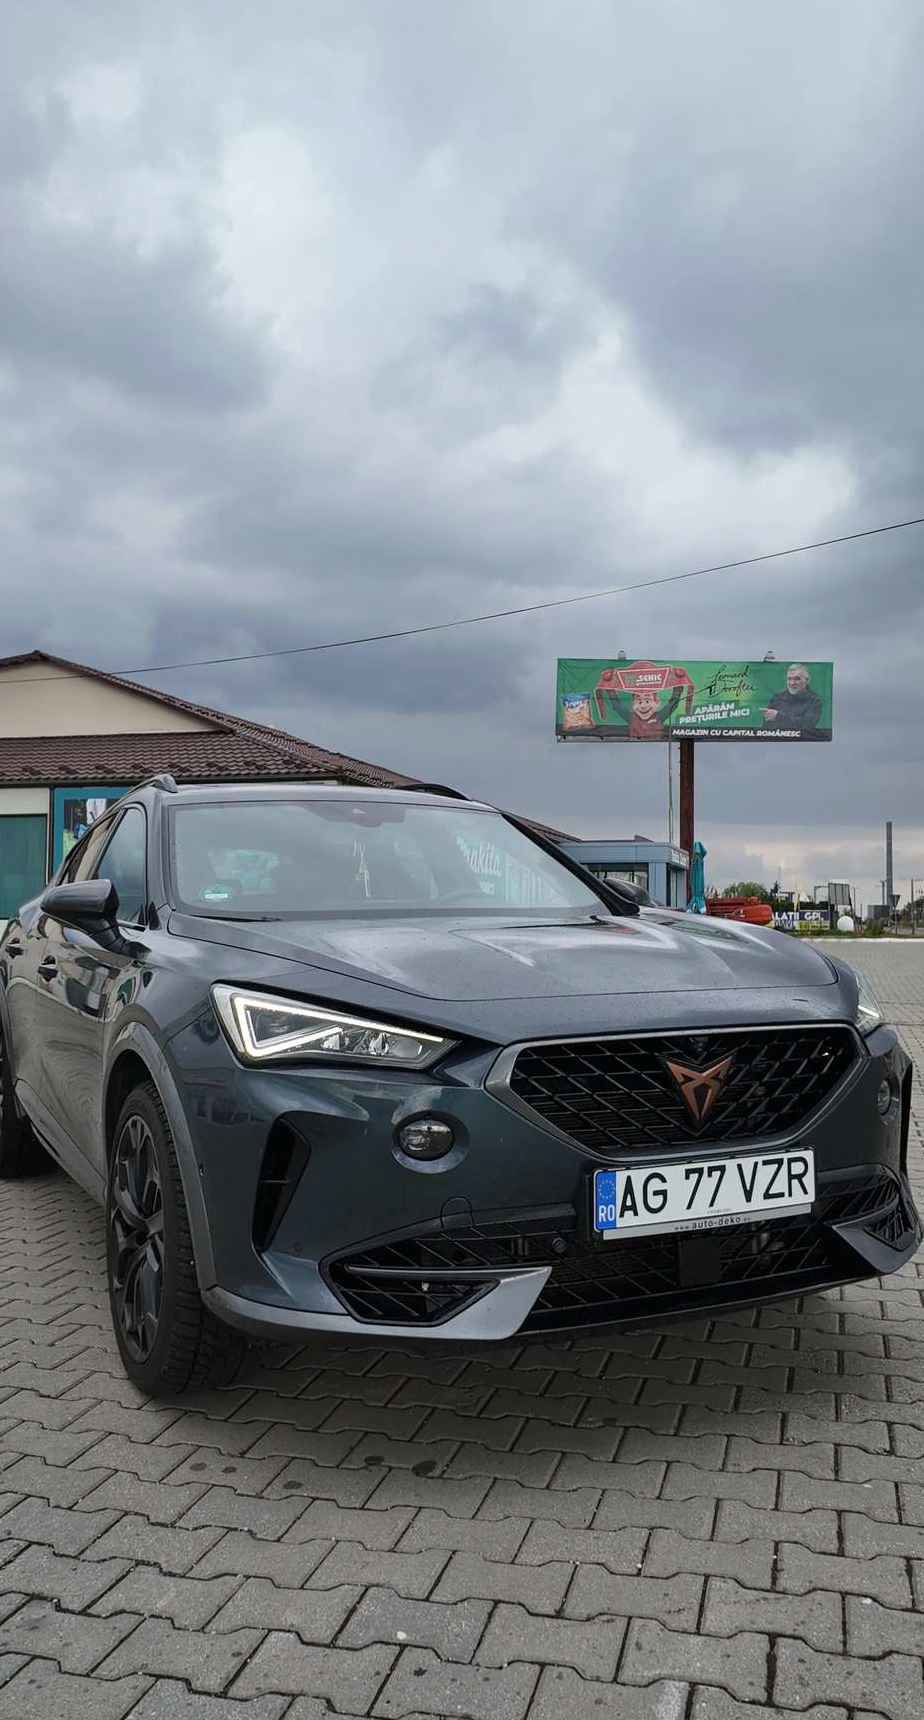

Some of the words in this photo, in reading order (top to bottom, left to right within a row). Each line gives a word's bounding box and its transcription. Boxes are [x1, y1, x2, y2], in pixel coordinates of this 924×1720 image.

[730, 708, 750, 718] MICI
[722, 729, 755, 737] CAPITAL
[618, 1172, 669, 1219] AG
[684, 1164, 727, 1210] 77
[736, 1155, 810, 1204] VZR
[599, 1204, 616, 1222] RO
